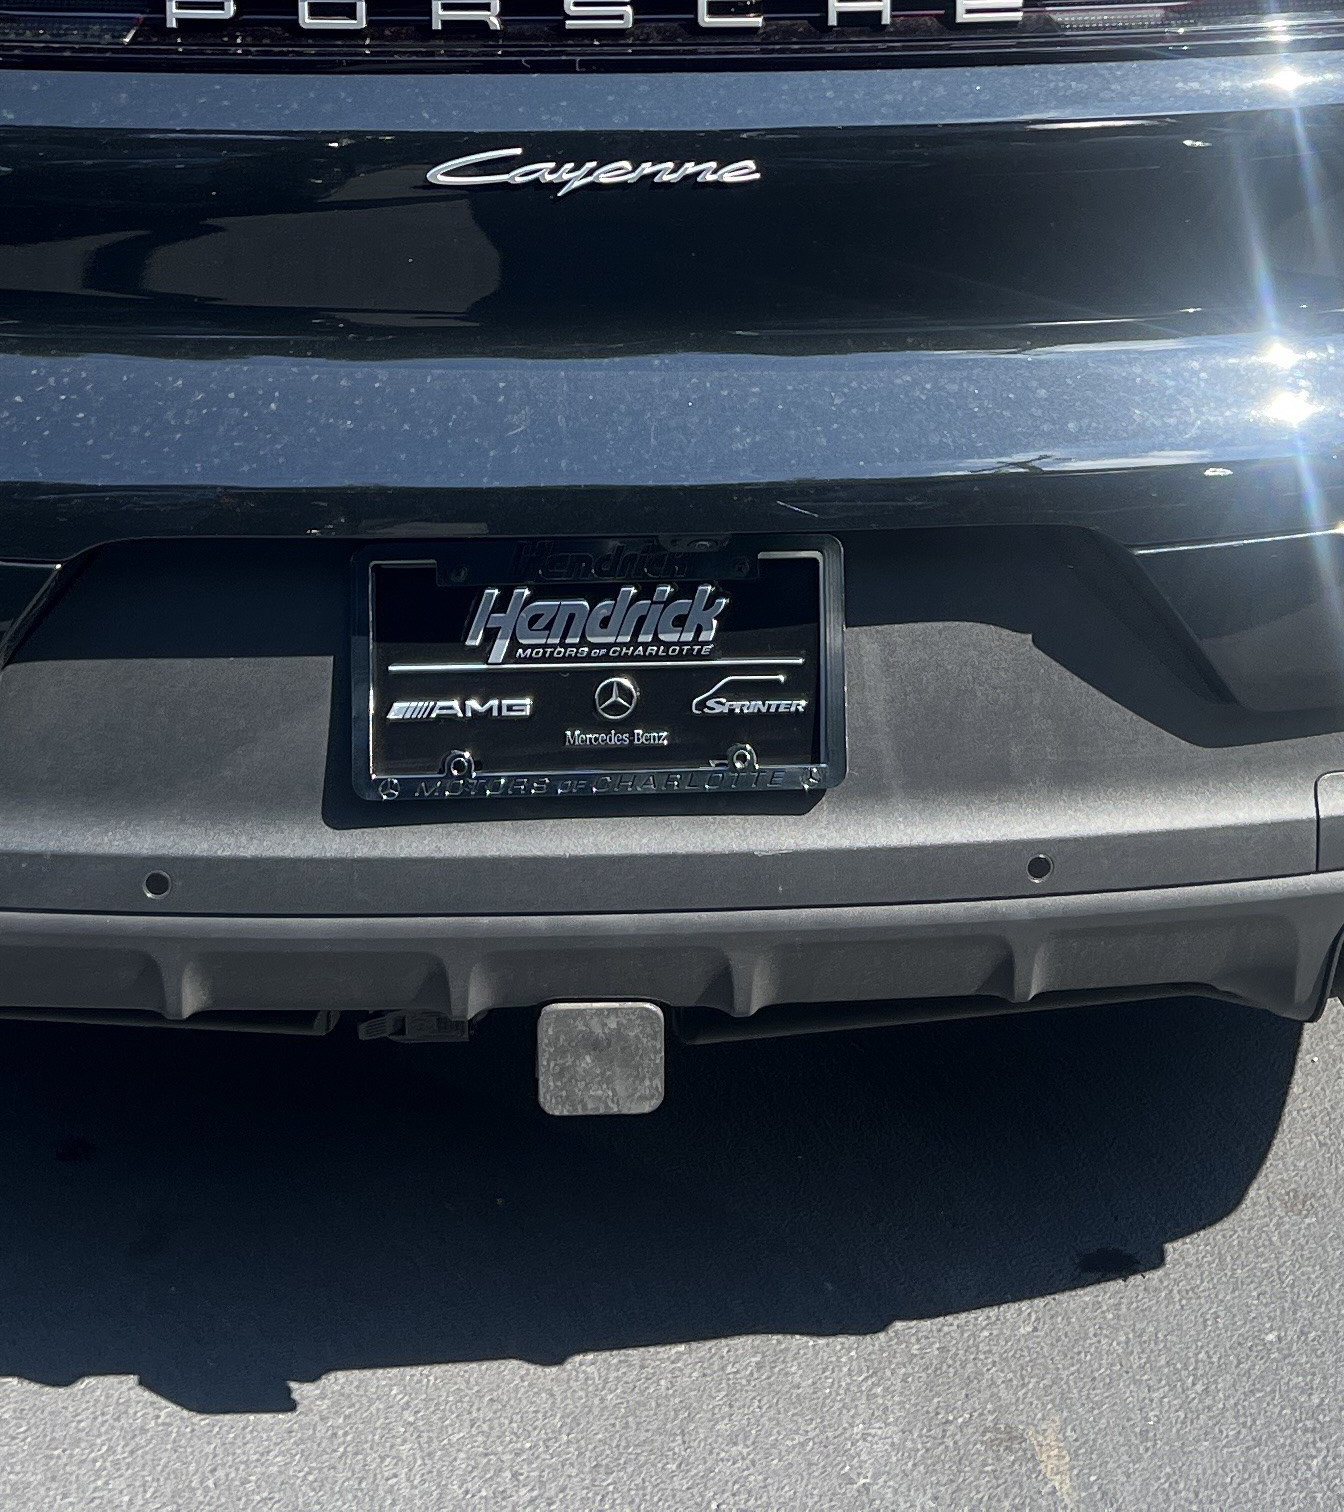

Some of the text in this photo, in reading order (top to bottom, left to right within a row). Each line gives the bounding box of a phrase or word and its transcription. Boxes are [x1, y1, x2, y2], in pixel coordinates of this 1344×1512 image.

[426, 147, 761, 198] Cayenne
[465, 584, 730, 664] Hendrick
[515, 645, 588, 659] MOTORS
[609, 644, 714, 658] CHARLOTTE
[703, 697, 808, 714] SPRINTER
[564, 729, 669, 747] Mercedes-Benz
[414, 777, 550, 797] MOTORS
[592, 770, 787, 793] CHARLOTTE
